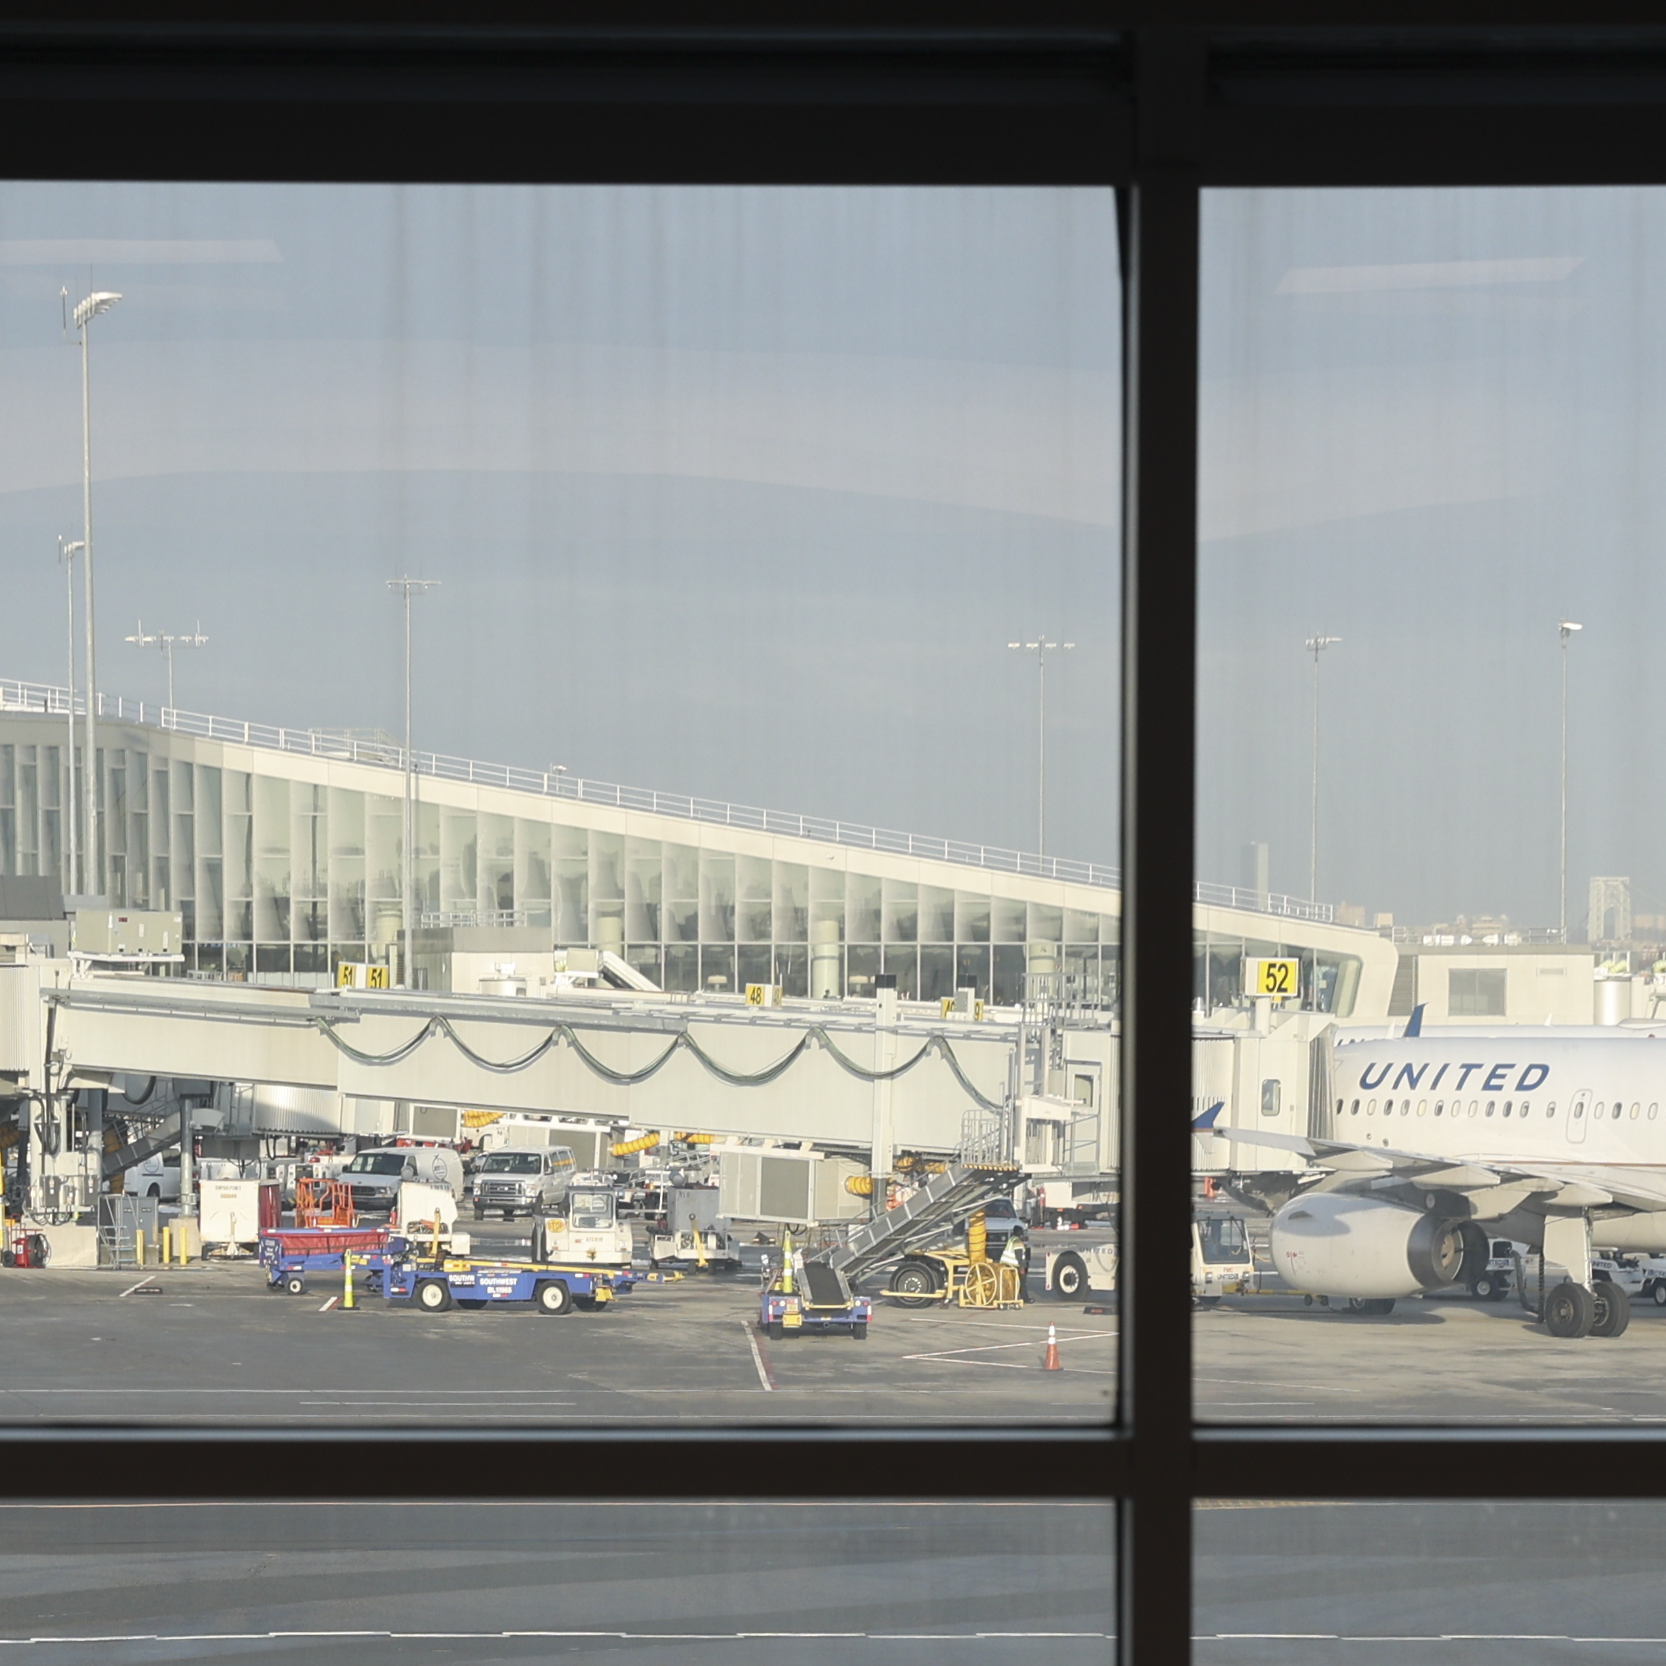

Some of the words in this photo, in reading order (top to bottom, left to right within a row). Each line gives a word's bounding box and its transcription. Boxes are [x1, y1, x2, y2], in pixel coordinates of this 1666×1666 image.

[343, 966, 353, 986] 51
[370, 968, 383, 989] 51
[1265, 963, 1289, 993] 52
[749, 986, 762, 1005] 48
[1359, 1062, 1550, 1091] UNITED
[1079, 1247, 1115, 1255] UNITED
[479, 1277, 518, 1286] SOUTHWEST
